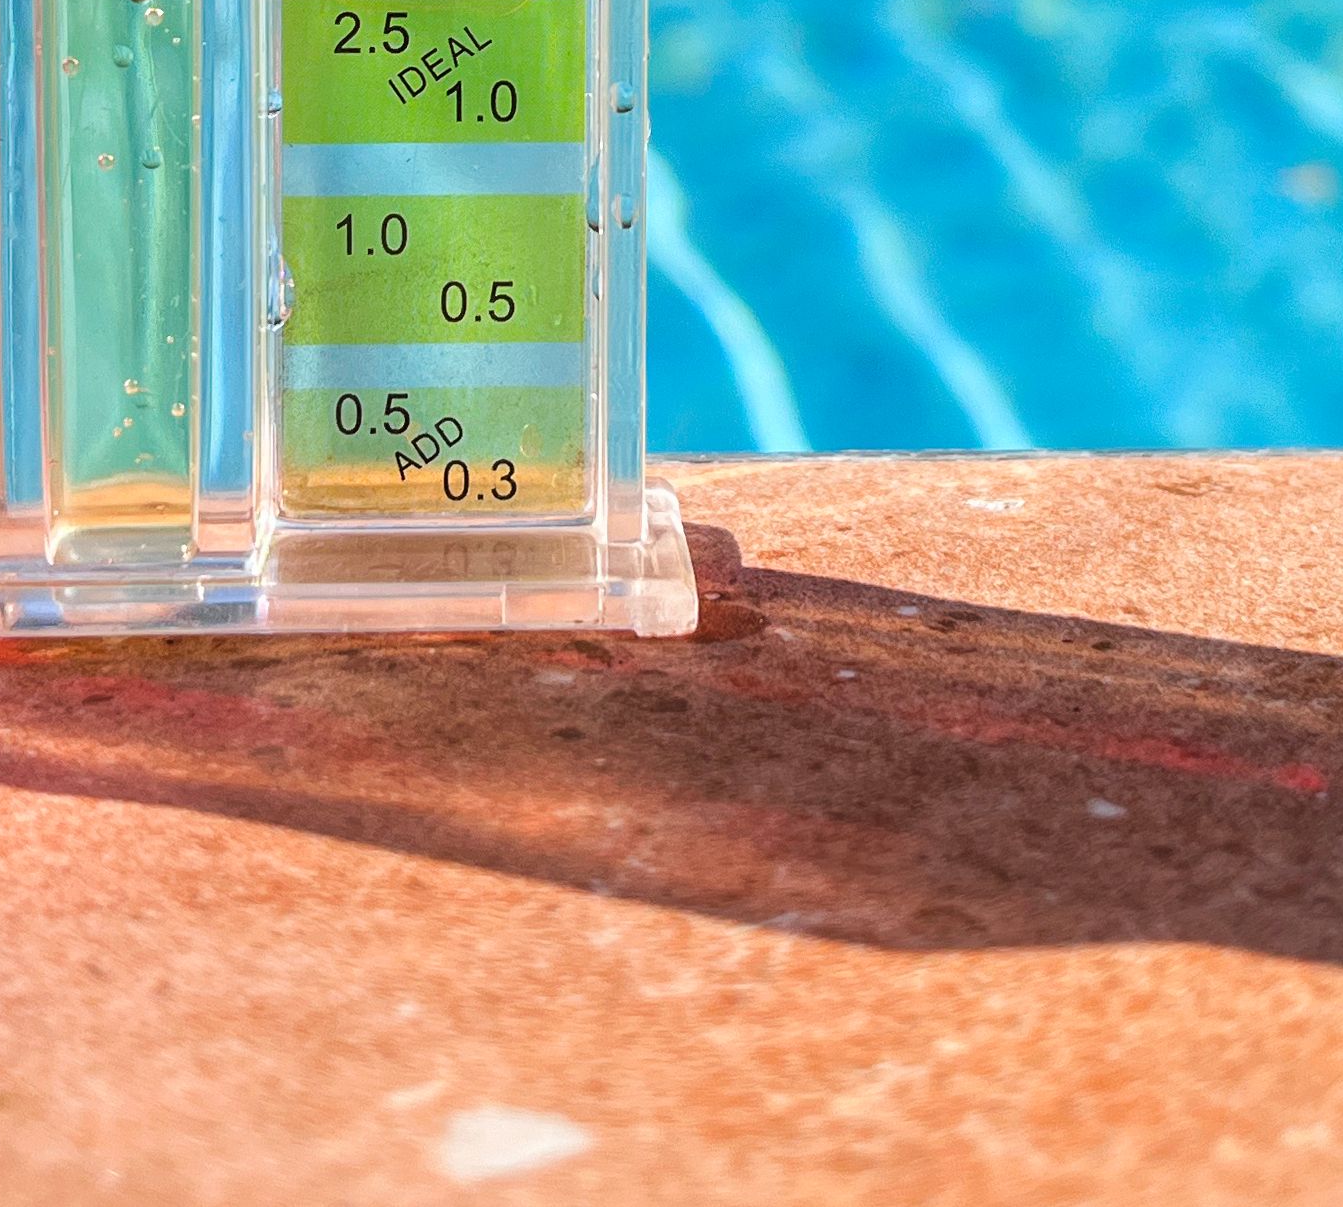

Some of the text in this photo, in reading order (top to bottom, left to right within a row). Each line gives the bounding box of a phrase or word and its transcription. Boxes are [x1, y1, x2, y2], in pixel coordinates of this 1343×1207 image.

[333, 11, 410, 54] 2.5
[387, 25, 492, 105] IDEAL
[446, 79, 517, 123] 1.0
[336, 213, 408, 256] 1.0
[440, 280, 516, 323] 0.5
[335, 393, 410, 435] 0.5
[393, 416, 464, 480] ADD
[443, 458, 517, 501] 0.3
